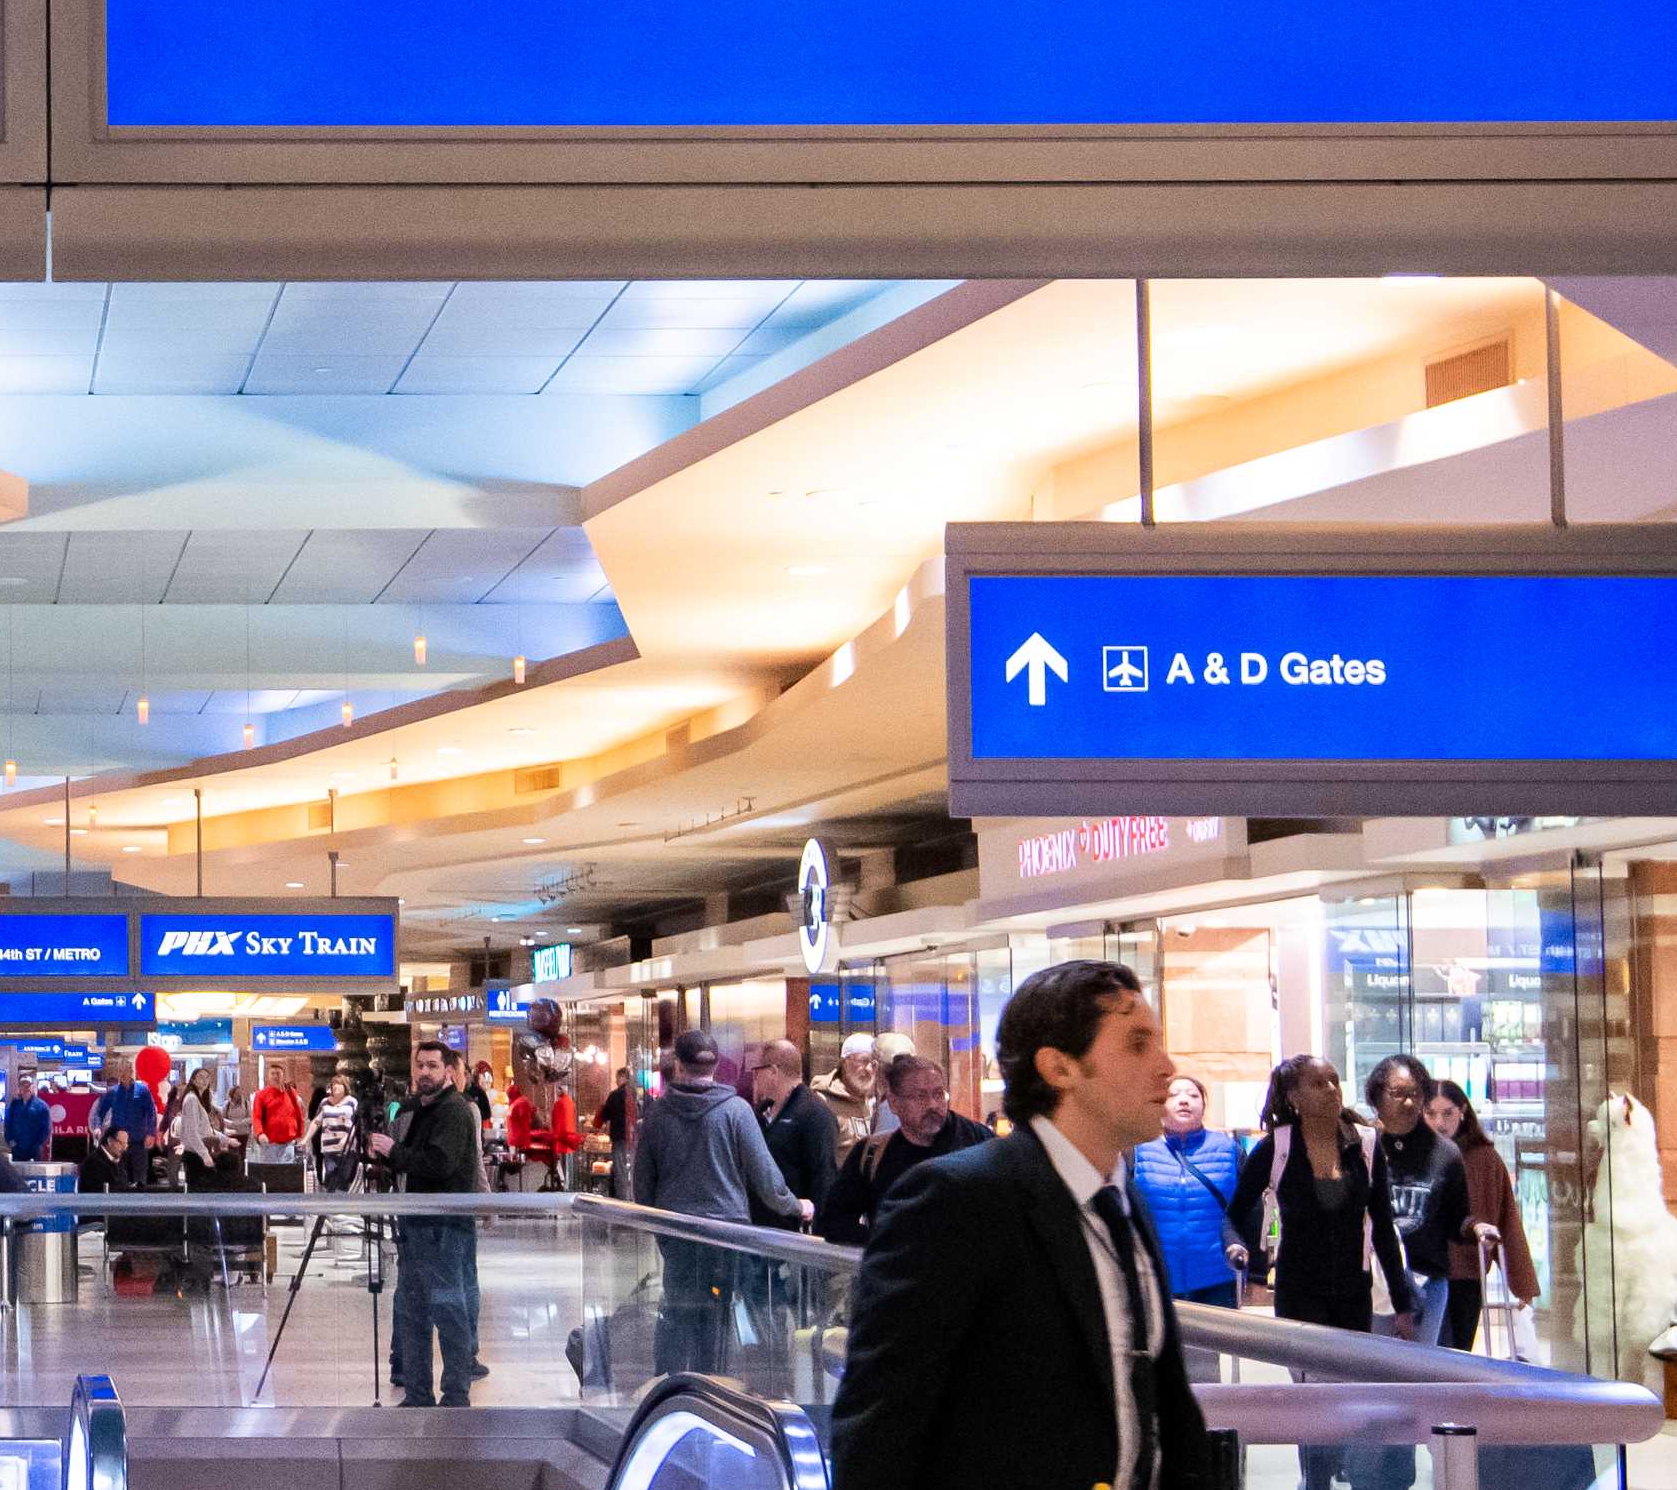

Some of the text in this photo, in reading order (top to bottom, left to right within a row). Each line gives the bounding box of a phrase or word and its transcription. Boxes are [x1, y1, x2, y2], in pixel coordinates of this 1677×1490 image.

[1166, 652, 1388, 685] A & D Gates
[1019, 829, 1077, 878] PHOENIX
[26, 948, 43, 961] ST
[53, 948, 101, 961] METRO
[157, 931, 243, 956] PHX
